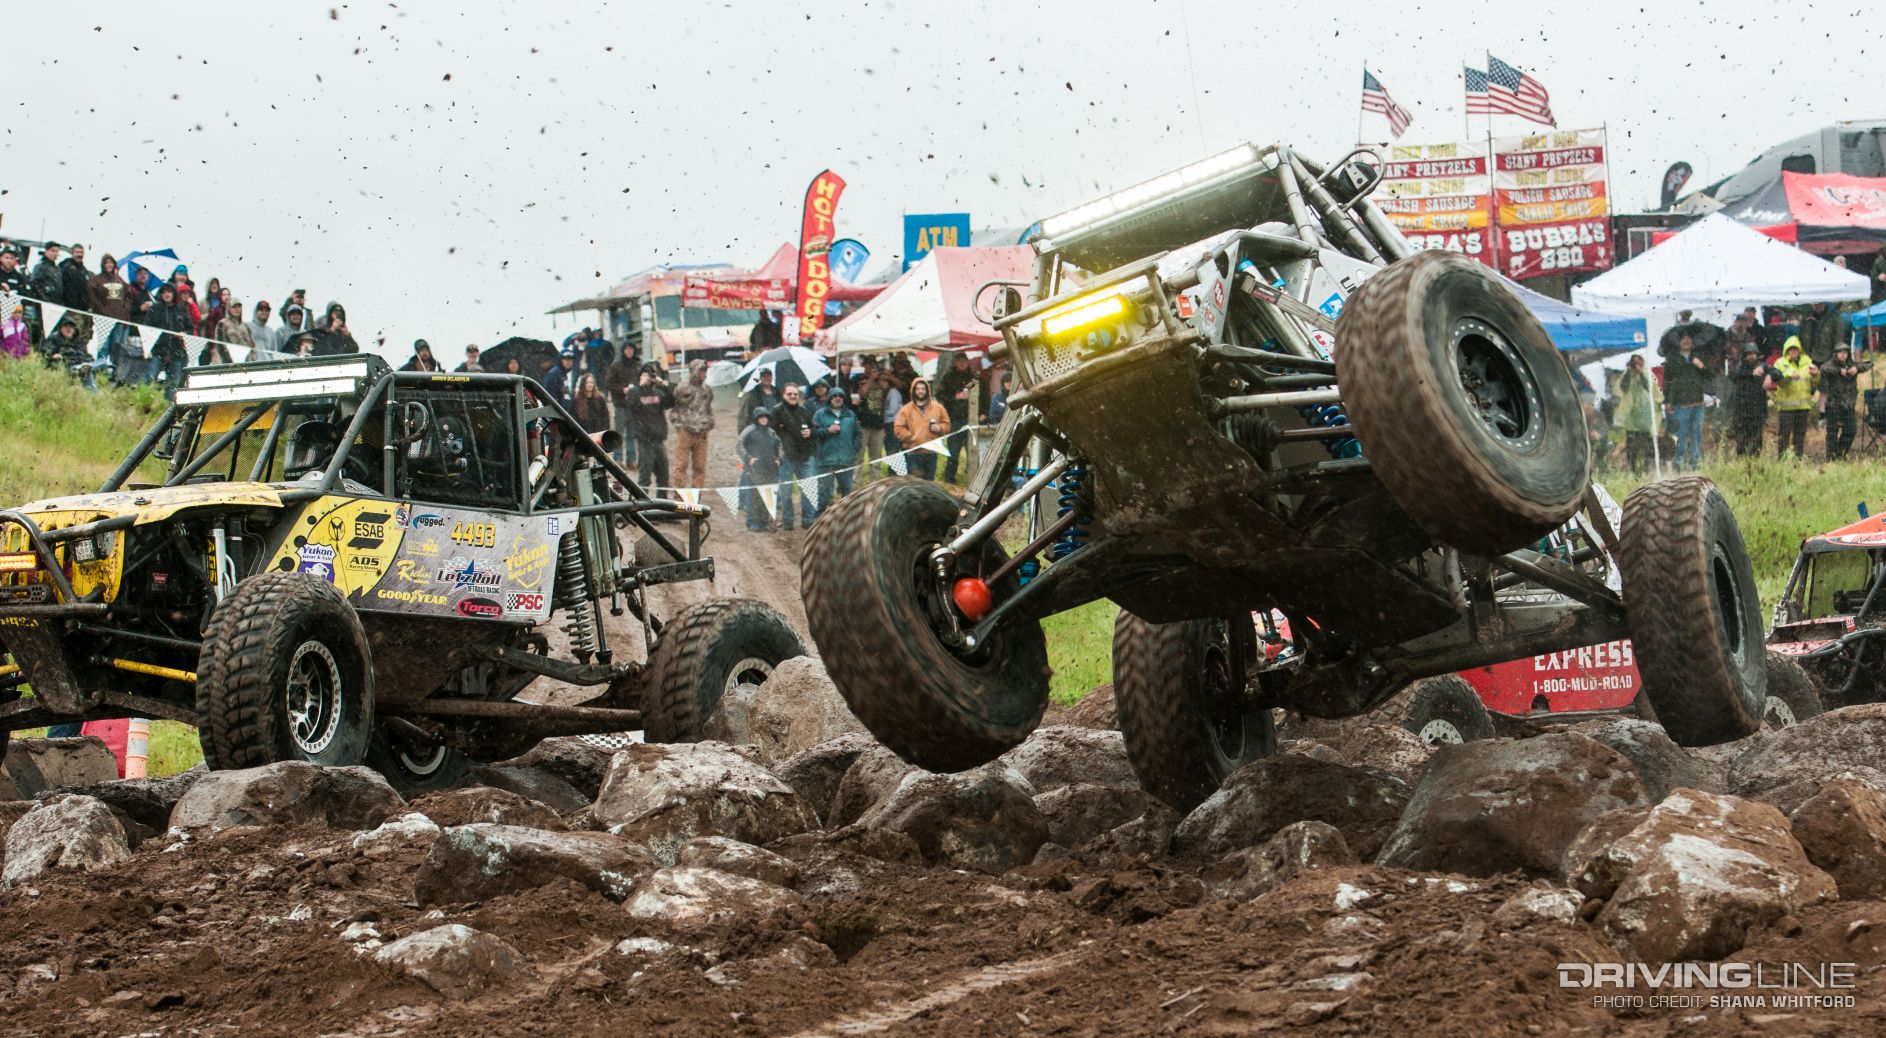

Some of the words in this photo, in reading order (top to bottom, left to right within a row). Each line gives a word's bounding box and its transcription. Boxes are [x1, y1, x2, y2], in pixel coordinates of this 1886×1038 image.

[1415, 159, 1476, 177] PRETZELS
[1504, 155, 1538, 169] GIANT
[1541, 149, 1596, 167] PRETZELS
[1425, 196, 1476, 211] SAUSAGE
[1508, 189, 1544, 204] POLISH
[1548, 185, 1595, 201] SAUSAGE
[812, 177, 837, 232] HOT
[916, 226, 959, 253] ATM
[1507, 222, 1606, 252] BUBBA'S
[1540, 246, 1585, 270] BBQ
[800, 259, 829, 335] DOGS
[354, 522, 385, 539] ESAB
[451, 520, 497, 549] 4493
[302, 546, 334, 556] Yukon
[349, 556, 380, 566] ADS
[377, 589, 449, 605] GOODYEAR
[514, 593, 544, 611] PSC
[463, 601, 500, 613] Torco
[1534, 640, 1633, 671] EXPRESS
[1533, 675, 1633, 694] 1-800-MUD-ROAD
